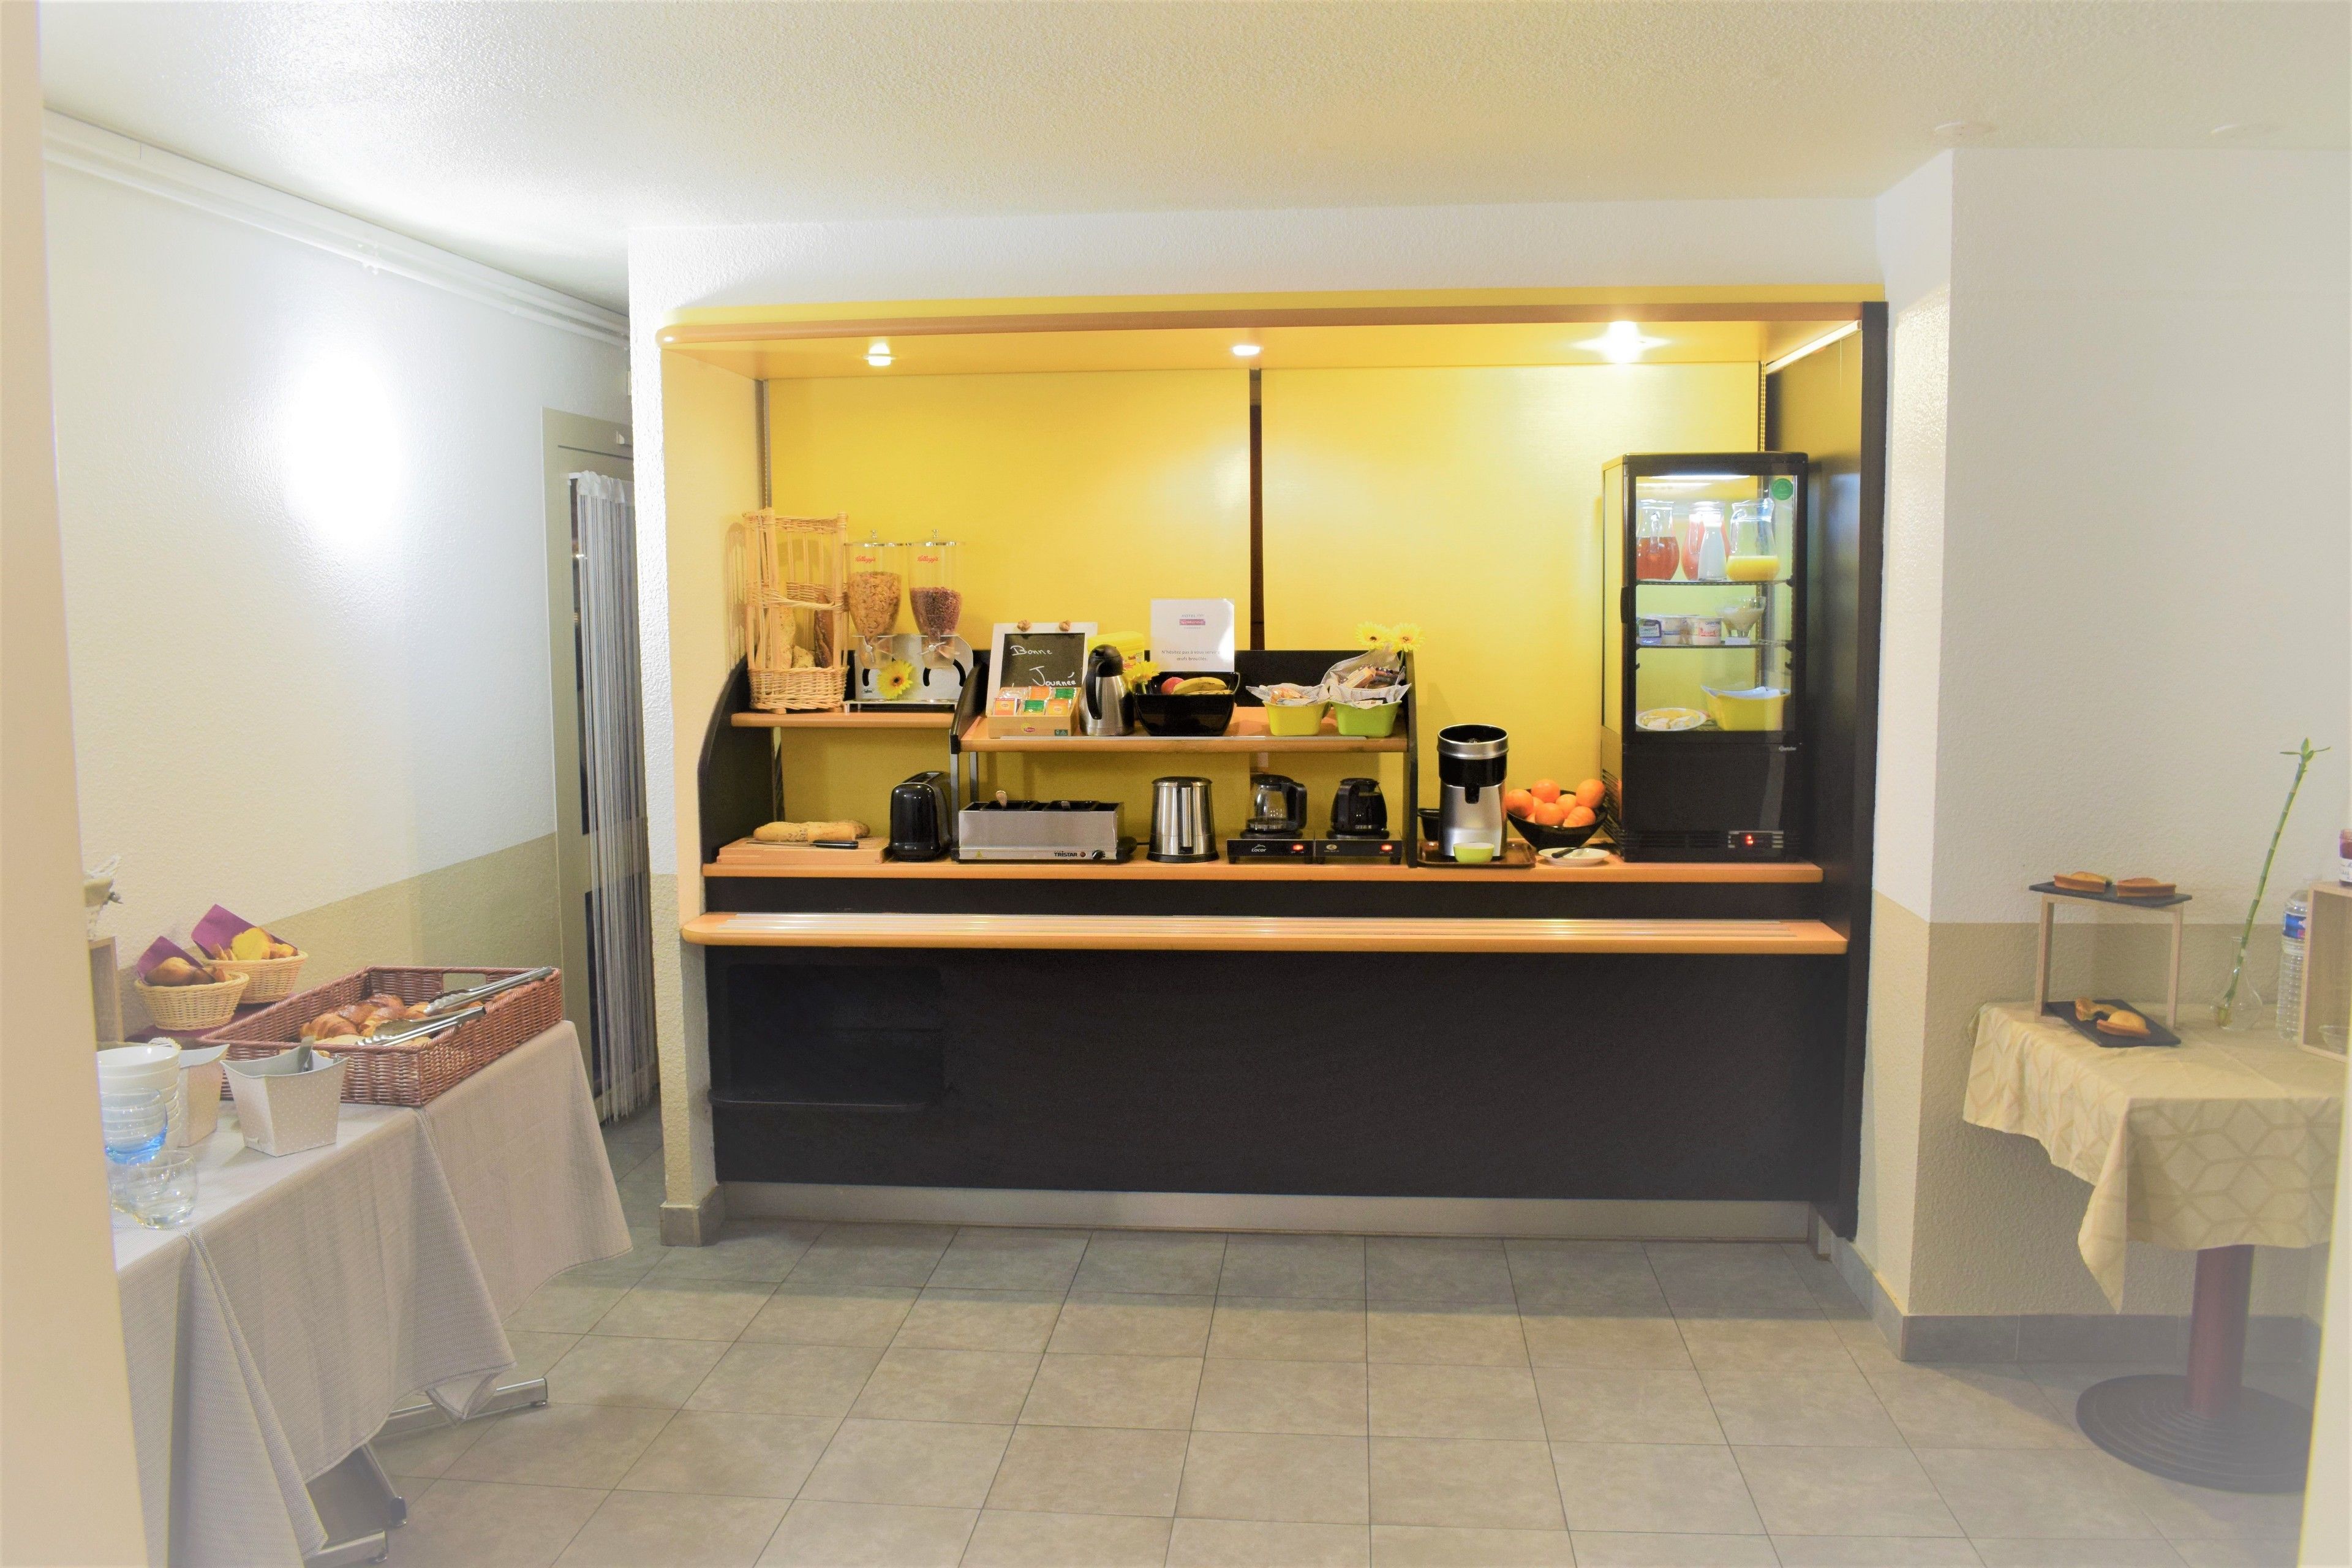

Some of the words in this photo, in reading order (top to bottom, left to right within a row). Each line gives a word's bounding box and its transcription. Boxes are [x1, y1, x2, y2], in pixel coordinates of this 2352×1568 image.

[855, 554, 876, 564] Kellogg's
[917, 554, 938, 564] Kellogg's
[1011, 645, 1053, 656] Bonne
